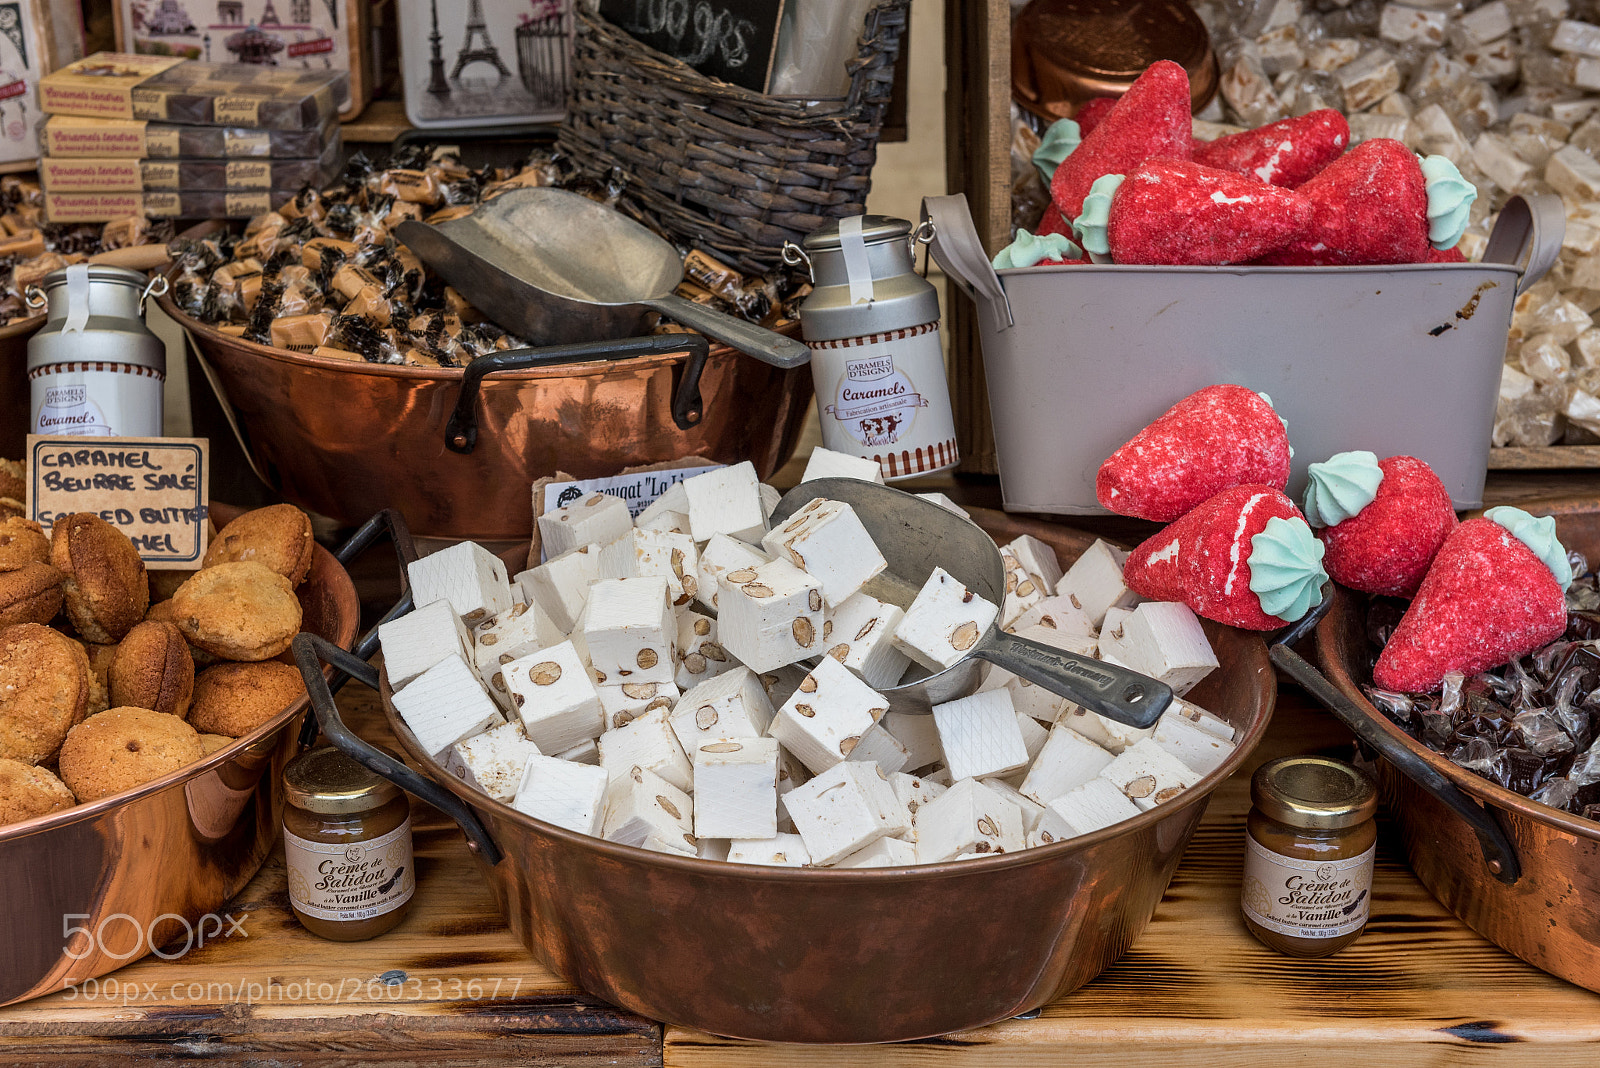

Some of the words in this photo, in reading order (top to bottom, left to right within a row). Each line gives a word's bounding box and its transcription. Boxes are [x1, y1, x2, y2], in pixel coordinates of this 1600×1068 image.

[848, 360, 891, 371] CARAMELS
[849, 366, 892, 378] D'ISIGNY
[46, 388, 84, 397] CARAMELS
[843, 382, 905, 401] Caramels
[845, 407, 878, 418] Fabrication
[879, 398, 908, 411] artisanale
[40, 412, 95, 427] Caramels
[42, 450, 162, 470] CARAMEL
[42, 471, 136, 492] BEURRE
[596, 480, 643, 500] ougat
[318, 859, 369, 876] Crème
[370, 858, 383, 868] de
[315, 869, 386, 890] Salidou
[1285, 875, 1338, 892] Crème
[1339, 878, 1351, 889] de
[334, 888, 378, 904] Vanille
[1278, 888, 1352, 905] Salidou
[1298, 909, 1341, 922] Vanille
